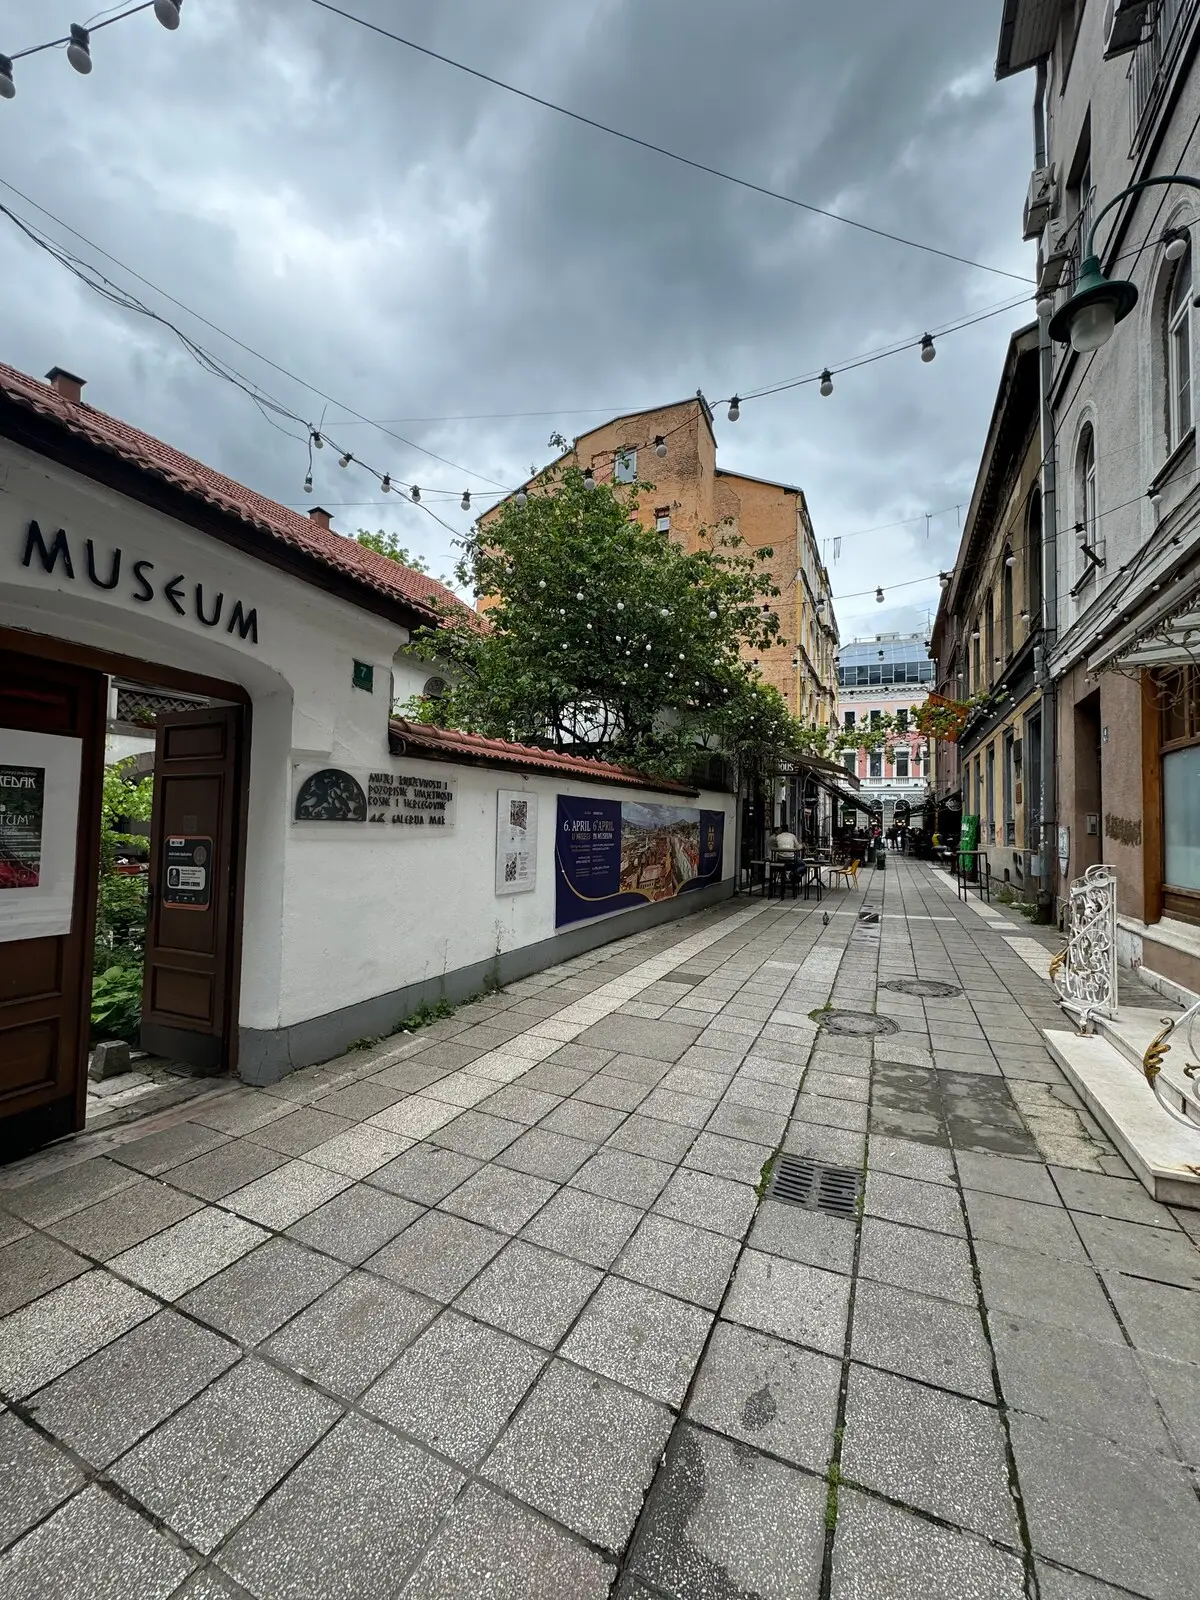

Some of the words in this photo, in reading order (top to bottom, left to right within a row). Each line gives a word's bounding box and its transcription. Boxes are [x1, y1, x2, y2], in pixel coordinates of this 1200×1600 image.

[22, 519, 258, 644] MUSEUM
[360, 666, 367, 678] 7
[572, 820, 591, 832] APRIL
[598, 820, 615, 832] APRIL
